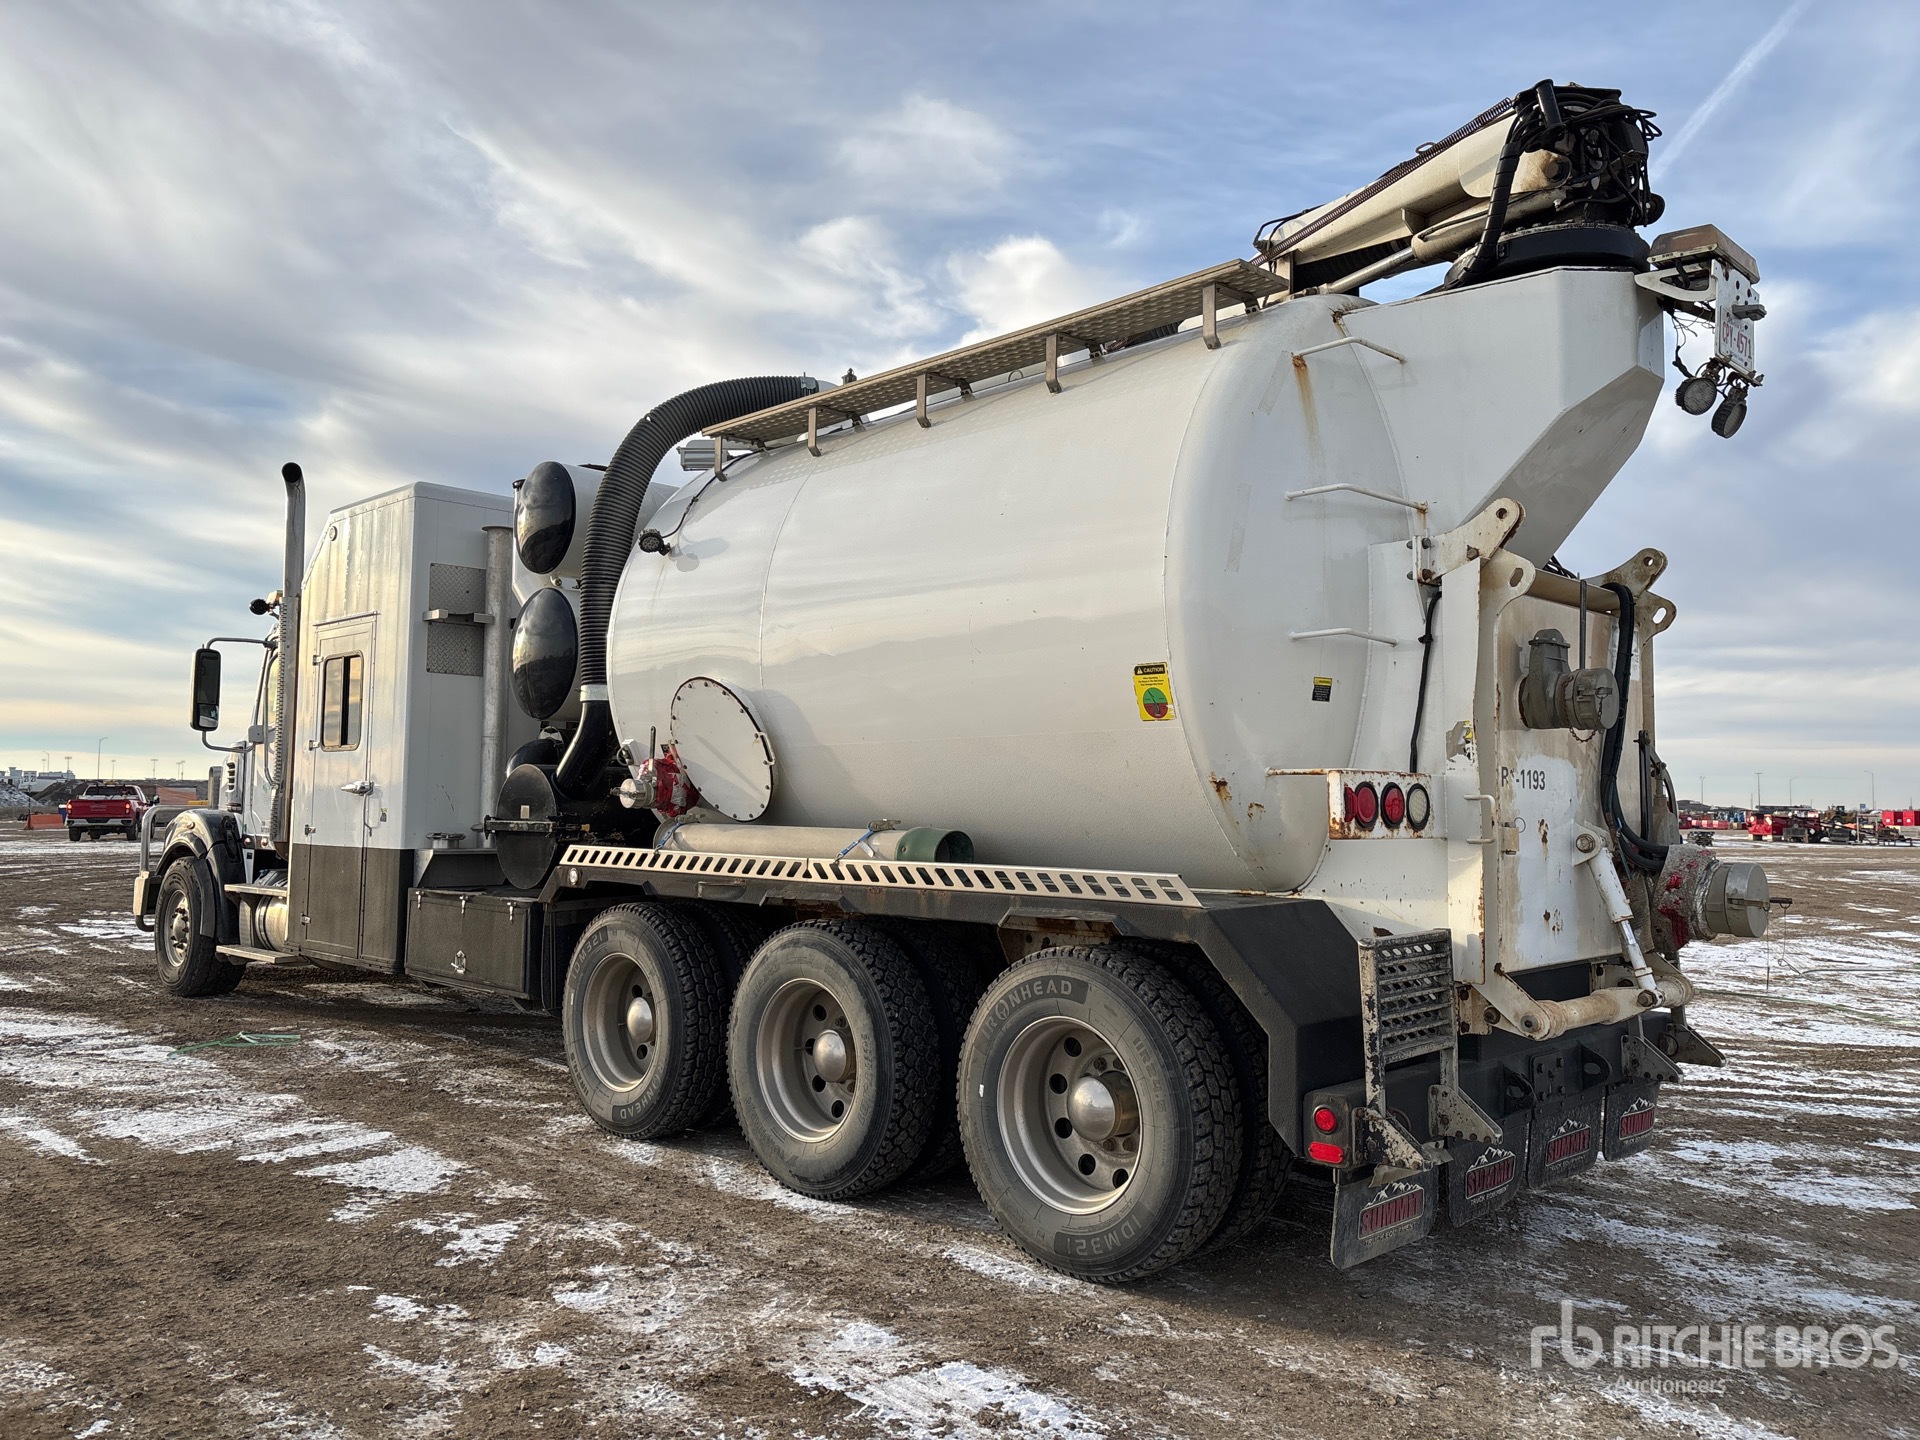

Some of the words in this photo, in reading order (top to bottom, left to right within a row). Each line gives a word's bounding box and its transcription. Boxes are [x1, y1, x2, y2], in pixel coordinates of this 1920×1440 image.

[1143, 666, 1164, 674] CAUTION
[1501, 766, 1546, 791] R-1193
[571, 931, 604, 980] IDM321
[981, 979, 1073, 1040] IRONHEAD
[1467, 1157, 1514, 1198] SUMMIT
[1361, 1190, 1422, 1236] SUMMIT
[1067, 1214, 1142, 1257] IDM321
